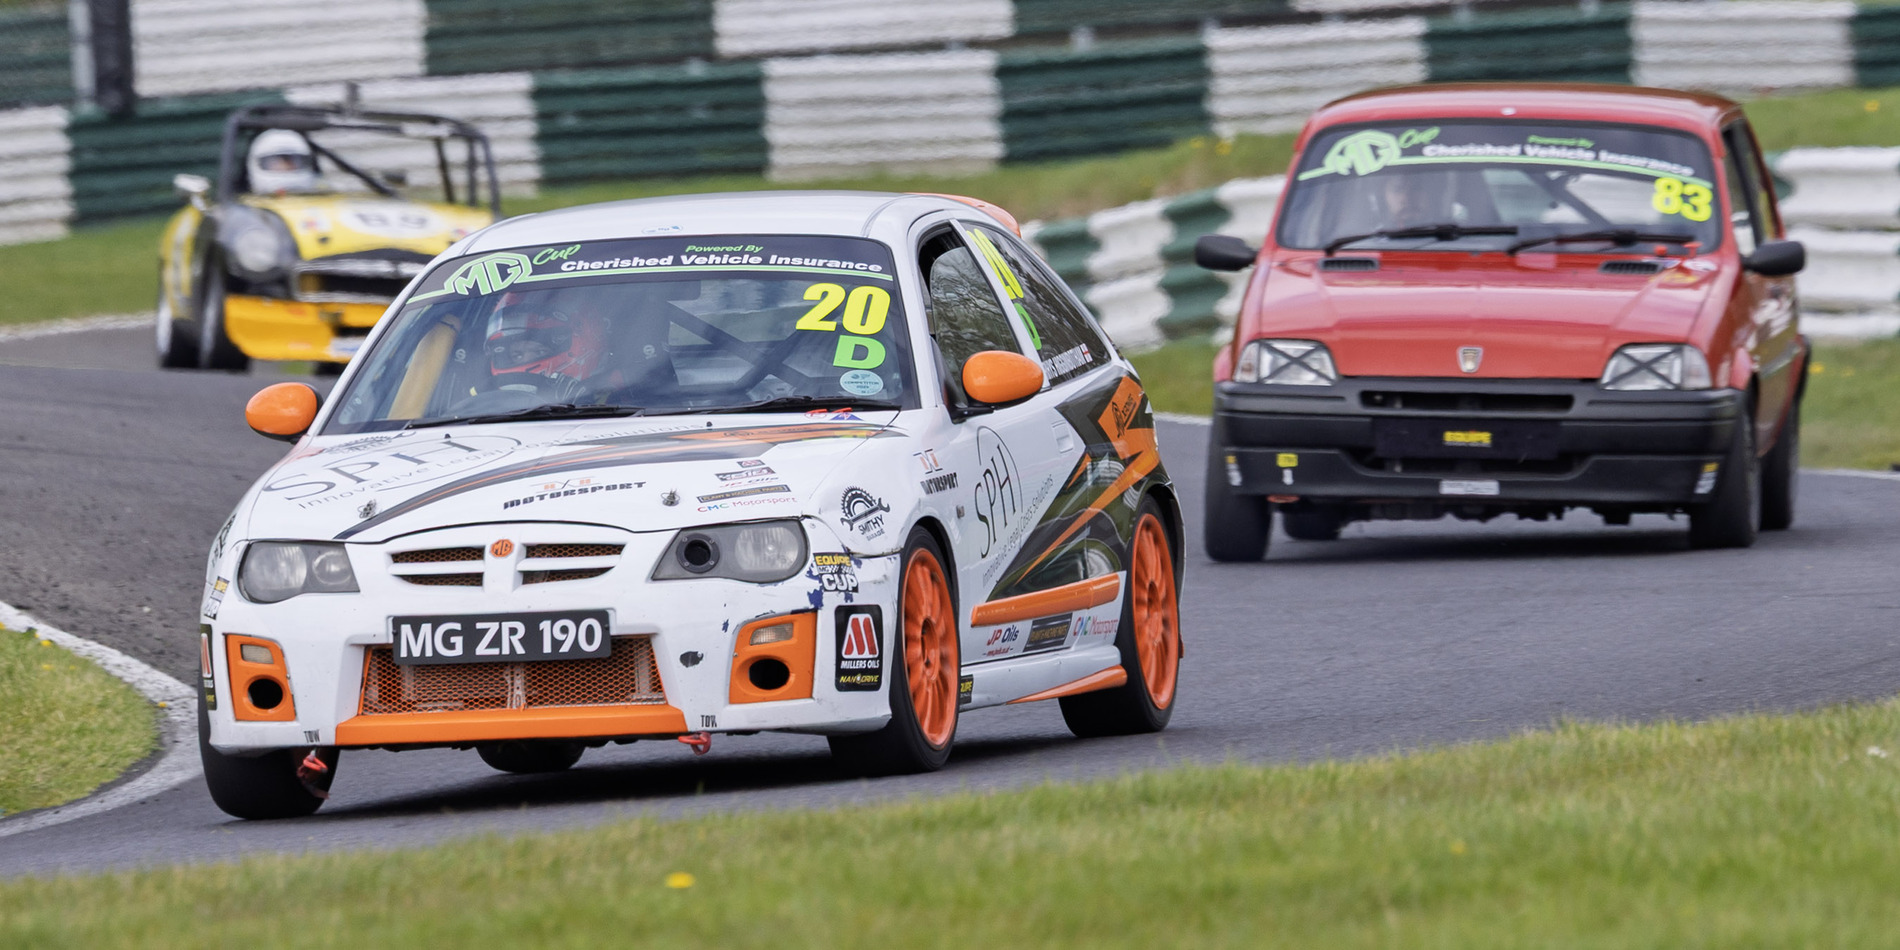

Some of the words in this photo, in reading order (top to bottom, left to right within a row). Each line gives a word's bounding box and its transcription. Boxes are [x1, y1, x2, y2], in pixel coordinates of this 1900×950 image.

[1330, 136, 1393, 175] MG
[1422, 143, 1521, 157] Cherished
[1523, 144, 1596, 161] Vehicle
[1598, 150, 1695, 176] Insurance
[1652, 177, 1714, 222] 83
[532, 243, 582, 266] Cup
[685, 245, 743, 253] Powered
[744, 245, 764, 254] By
[561, 255, 673, 272] Cherished
[680, 254, 763, 265] Vehicle
[769, 254, 883, 272] Insurance
[452, 256, 524, 296] MG
[795, 283, 891, 335] 20
[833, 335, 887, 370] D
[262, 440, 477, 501] SPH
[298, 465, 428, 509] Innovative
[435, 449, 502, 467] Legal
[919, 472, 959, 495] MOTORSPORT
[503, 481, 647, 510] MOTORSPORT
[697, 502, 730, 513] CMC
[732, 497, 798, 508] Motorsport
[975, 444, 1017, 559] SPH
[858, 514, 885, 536] SMITHY
[490, 539, 514, 558] MG
[816, 554, 852, 568] EQUIPE
[822, 573, 858, 592] CUP
[399, 621, 464, 658] MG
[475, 620, 526, 656] ZR
[539, 617, 603, 656] 190
[986, 629, 1002, 646] JP
[1001, 624, 1019, 643] Oils
[840, 660, 866, 669] MILLERS
[867, 659, 880, 669] OILS
[701, 714, 718, 728] TOW
[303, 729, 320, 743] TOW
